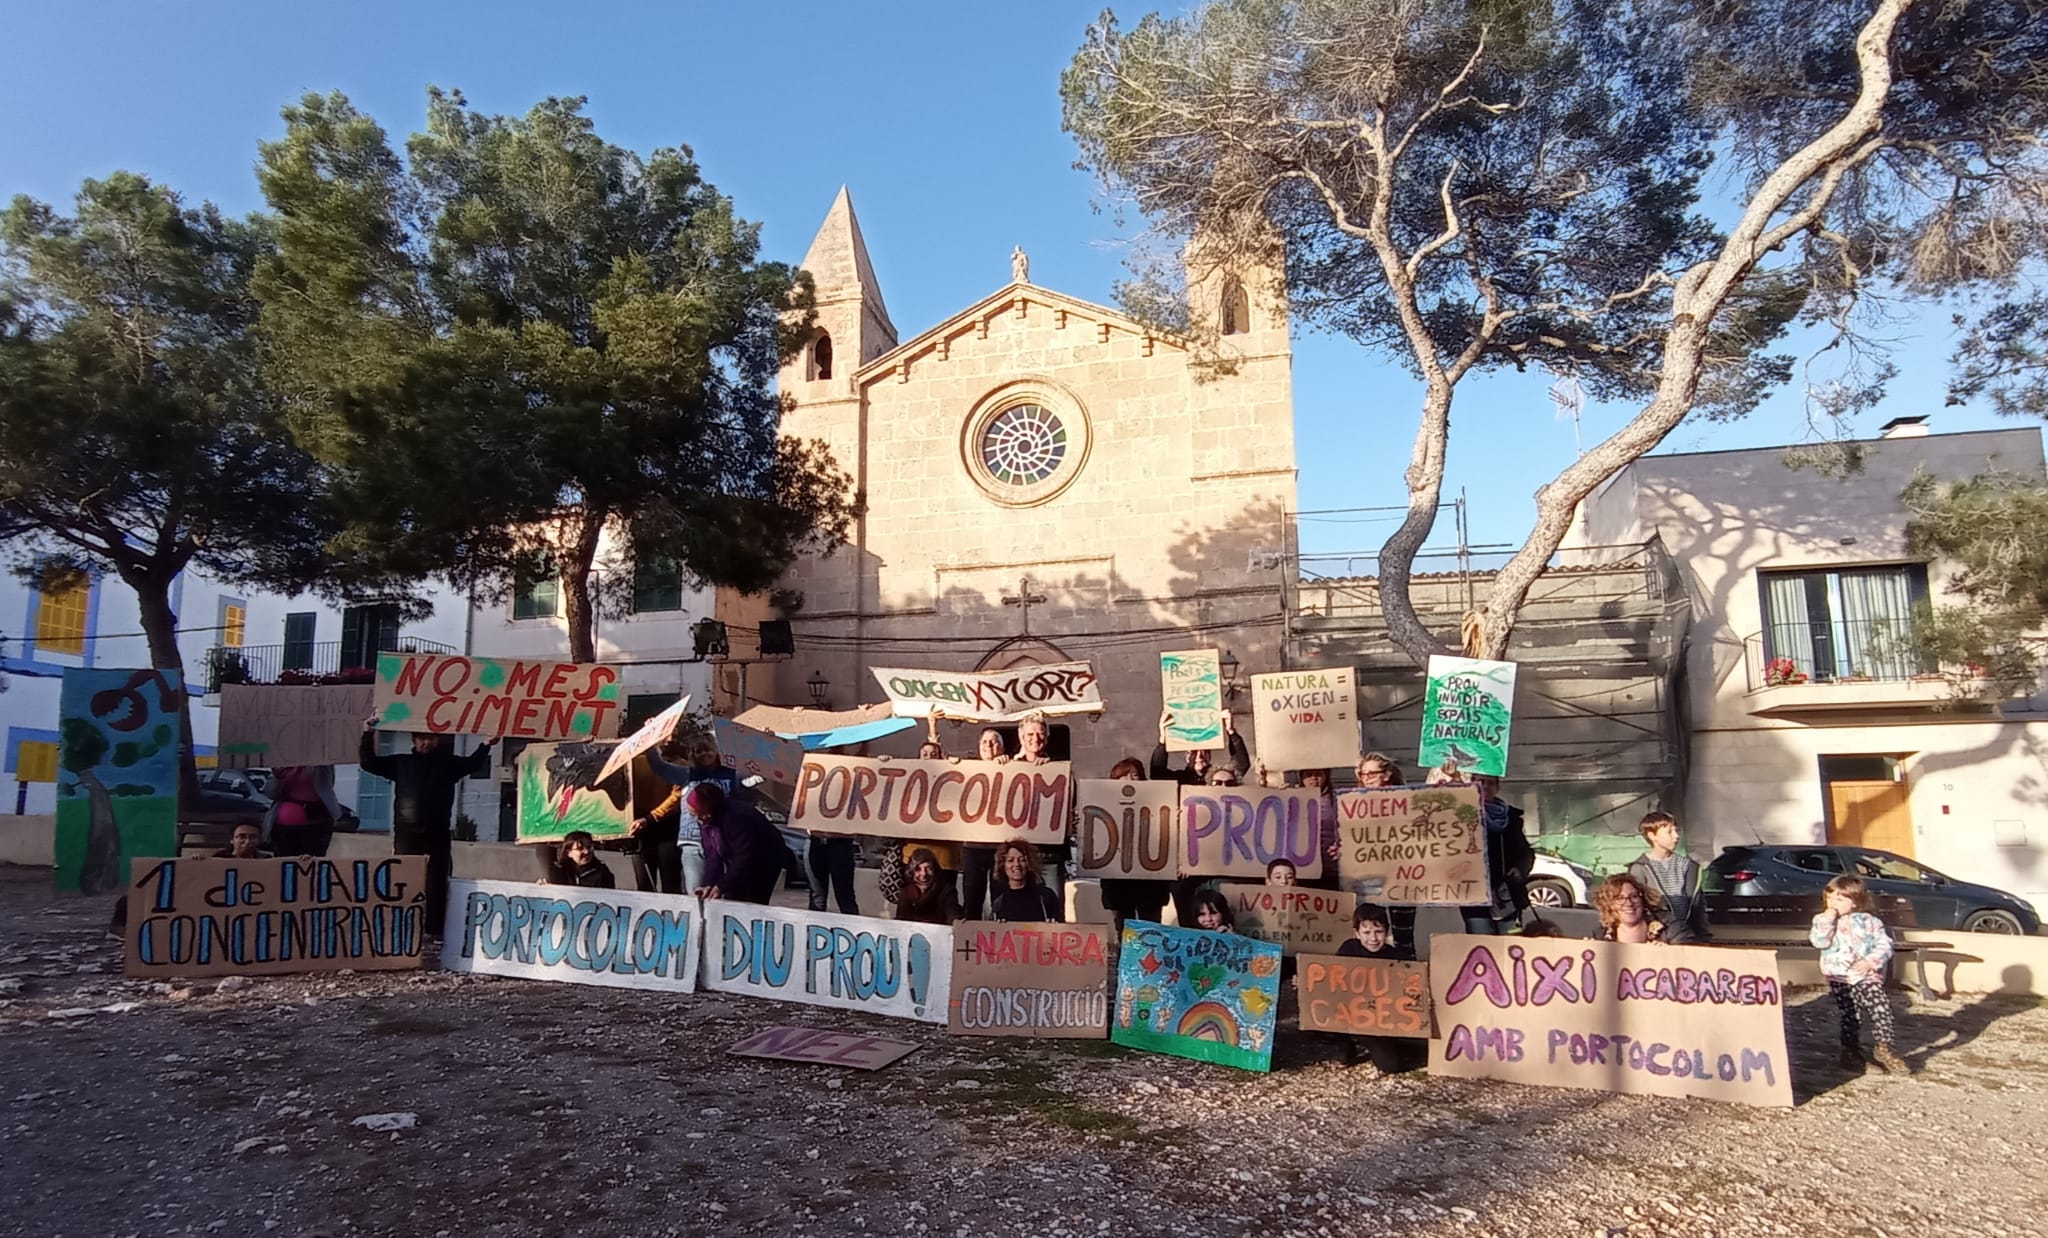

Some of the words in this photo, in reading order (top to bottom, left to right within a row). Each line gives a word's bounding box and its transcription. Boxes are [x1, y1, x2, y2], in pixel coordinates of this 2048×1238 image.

[505, 662, 616, 700] MES
[1262, 674, 1329, 691] NATURA
[426, 696, 616, 737] CIMENT
[1271, 690, 1335, 712] OXIGEN
[1289, 712, 1325, 723] VIDA
[1434, 724, 1506, 746] NATURALS
[794, 762, 1067, 831] PORTOCOLOM
[1341, 798, 1408, 819] VOLEM
[1183, 795, 1318, 867] PROU
[1354, 841, 1461, 863] GARROVES
[136, 859, 176, 913] 1
[204, 869, 265, 907] de
[281, 858, 407, 903] MAIG
[1396, 864, 1425, 880] NO
[1387, 880, 1478, 901] CIMENT
[138, 892, 425, 966] CONCENTRACIÓ
[462, 891, 690, 980] PORTOCOLOM
[1246, 929, 1292, 942] OLEM
[721, 914, 794, 987] DIU
[1306, 962, 1390, 997] PROU
[1617, 967, 1778, 1006] ACABAREM
[1445, 1024, 1525, 1062] AMB
[1547, 1029, 1776, 1088] PORTOCOLOM
